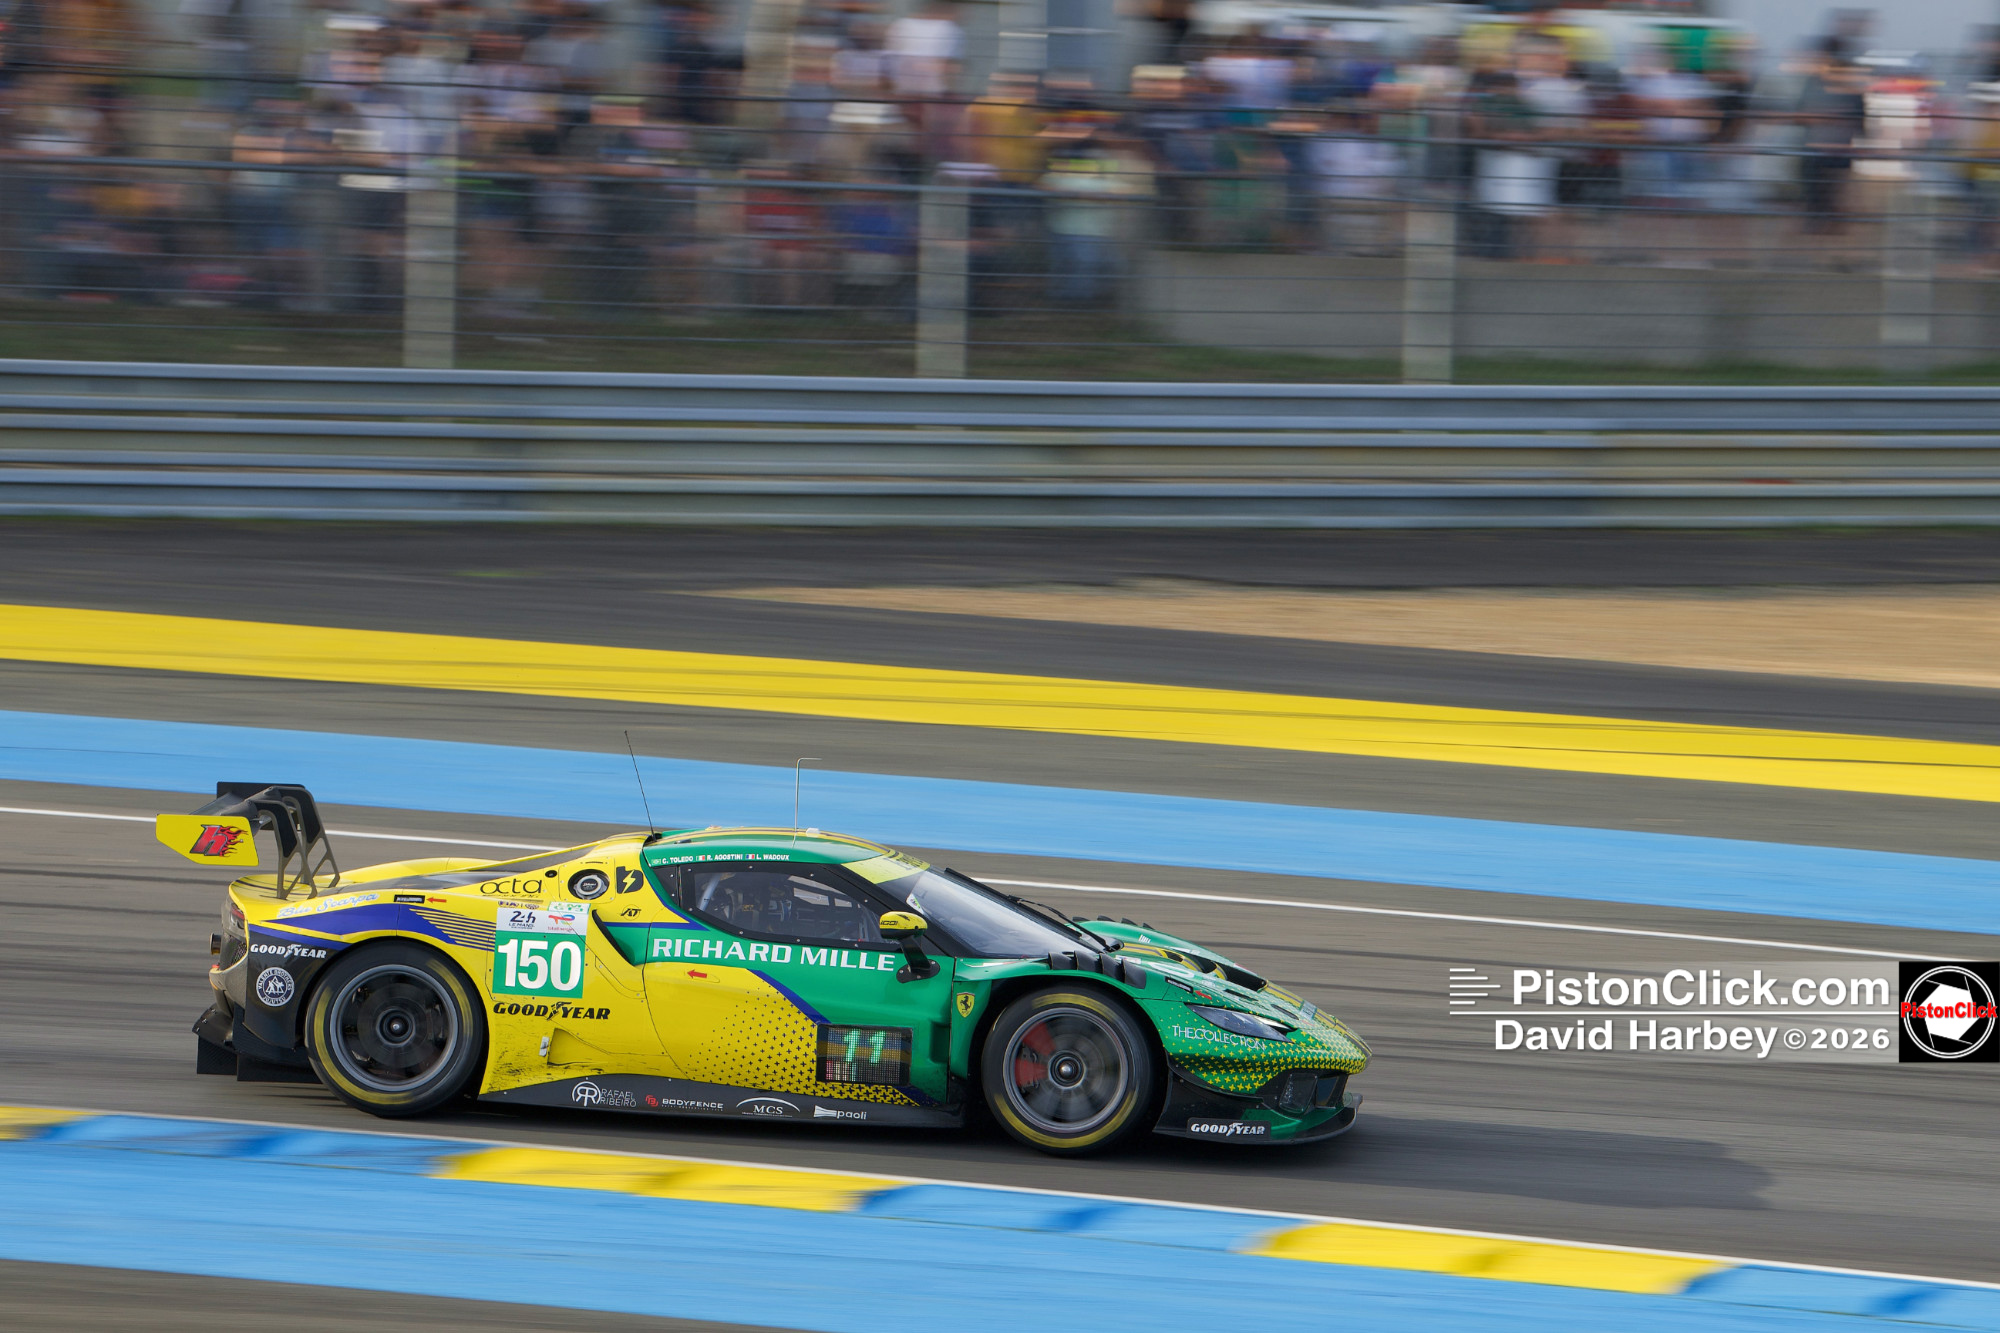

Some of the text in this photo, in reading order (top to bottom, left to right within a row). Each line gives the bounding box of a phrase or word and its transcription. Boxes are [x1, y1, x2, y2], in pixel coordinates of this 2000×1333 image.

[480, 878, 542, 894] octa
[652, 938, 896, 972] RICHARD MILLE
[498, 939, 581, 991] 150
[843, 1028, 887, 1064] 11
[601, 1088, 634, 1100] RAFAEL
[600, 1097, 637, 1108] RIBEIRO
[662, 1098, 724, 1109] BODYFENCE
[753, 1104, 783, 1115] MCS
[837, 1110, 867, 1120] paoli
